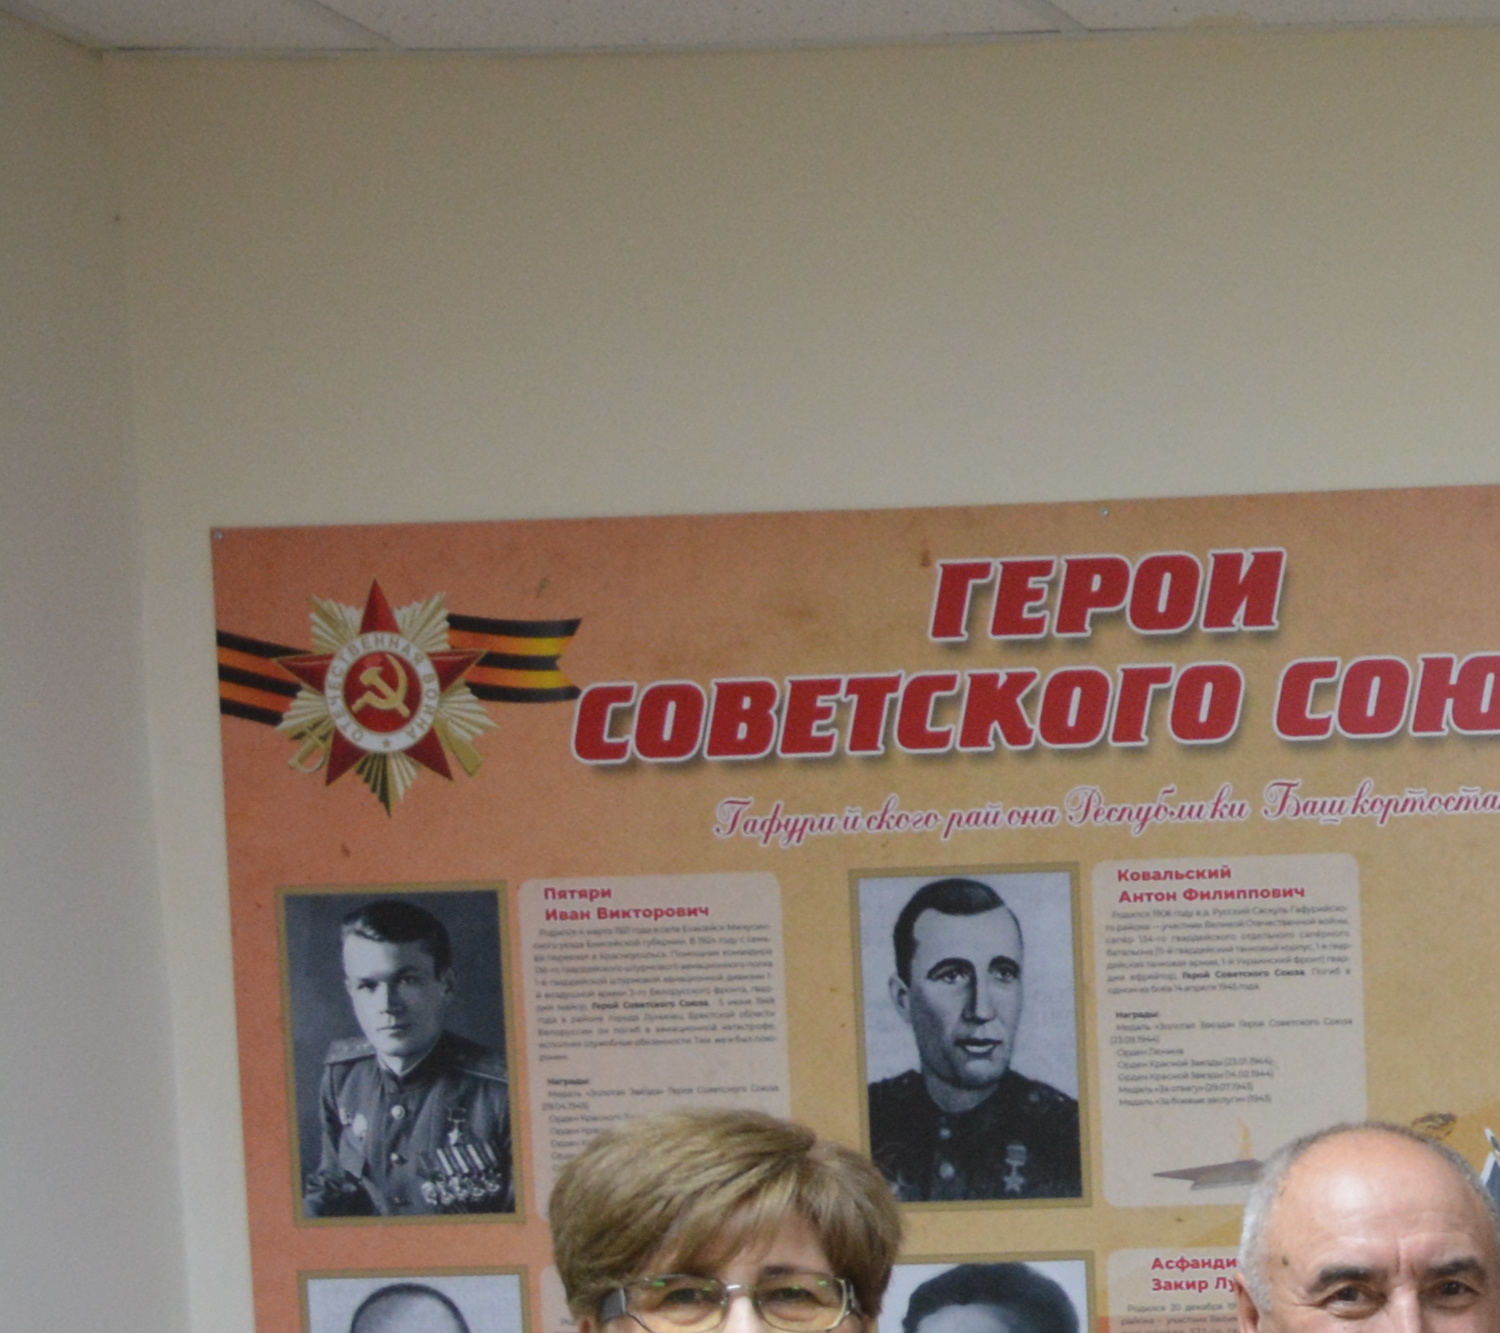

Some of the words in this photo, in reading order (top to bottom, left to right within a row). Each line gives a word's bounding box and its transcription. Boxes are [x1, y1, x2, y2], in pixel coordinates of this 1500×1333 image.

[928, 546, 1288, 643] ГЕРОИ
[571, 662, 1245, 764] СОВЕТСКОГО
[713, 794, 942, 848] Гафурийского
[942, 800, 1057, 840] района
[1064, 783, 1249, 837] Республики
[1116, 864, 1232, 883] Ковальский
[543, 886, 613, 903] Пятяри
[1118, 889, 1178, 904] Антон
[1182, 885, 1306, 903] Филиппович
[544, 908, 591, 922] Иван
[596, 905, 710, 922] Викторович
[1151, 1255, 1238, 1273] Асфанди
[1151, 1277, 1209, 1294] Закир
